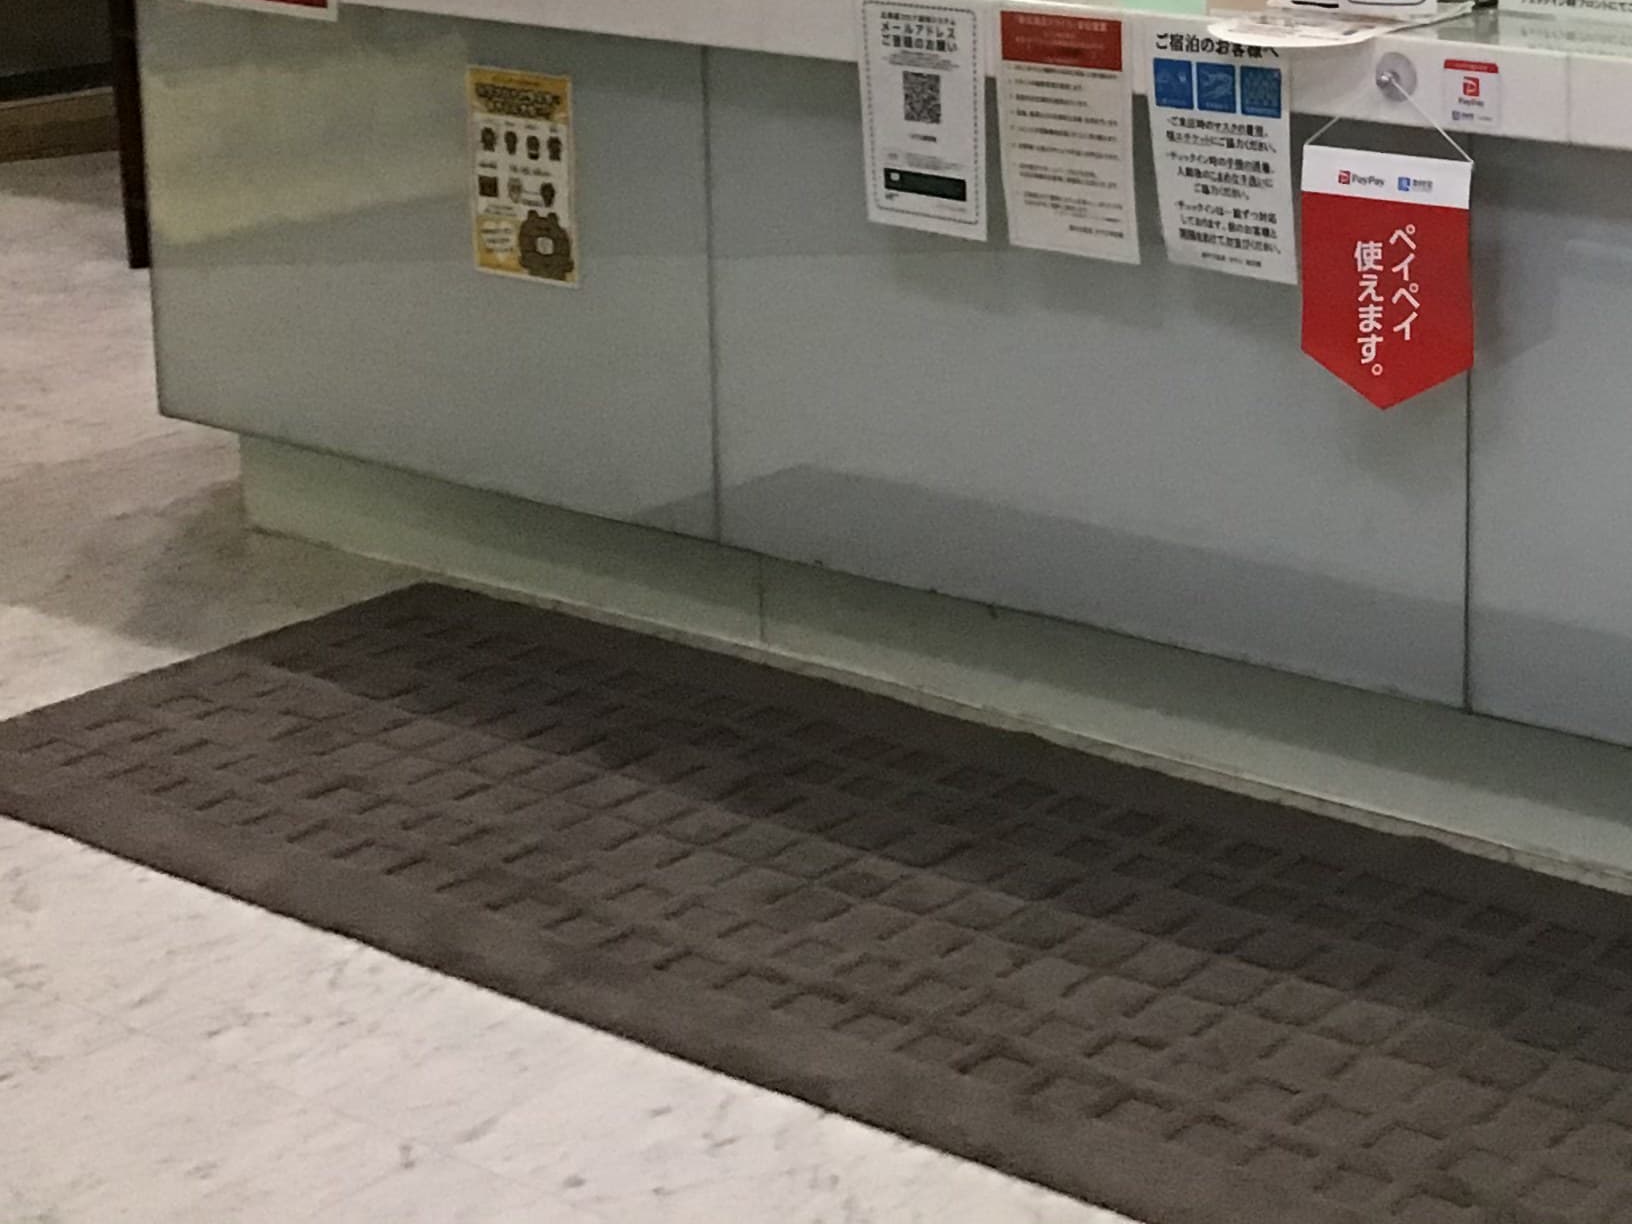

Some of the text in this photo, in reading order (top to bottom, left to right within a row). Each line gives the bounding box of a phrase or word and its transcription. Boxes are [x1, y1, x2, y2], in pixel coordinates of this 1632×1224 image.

[1351, 174, 1385, 188] PayPay
[1353, 241, 1385, 376] 使えます。
[1389, 224, 1420, 341] ペイペイ
